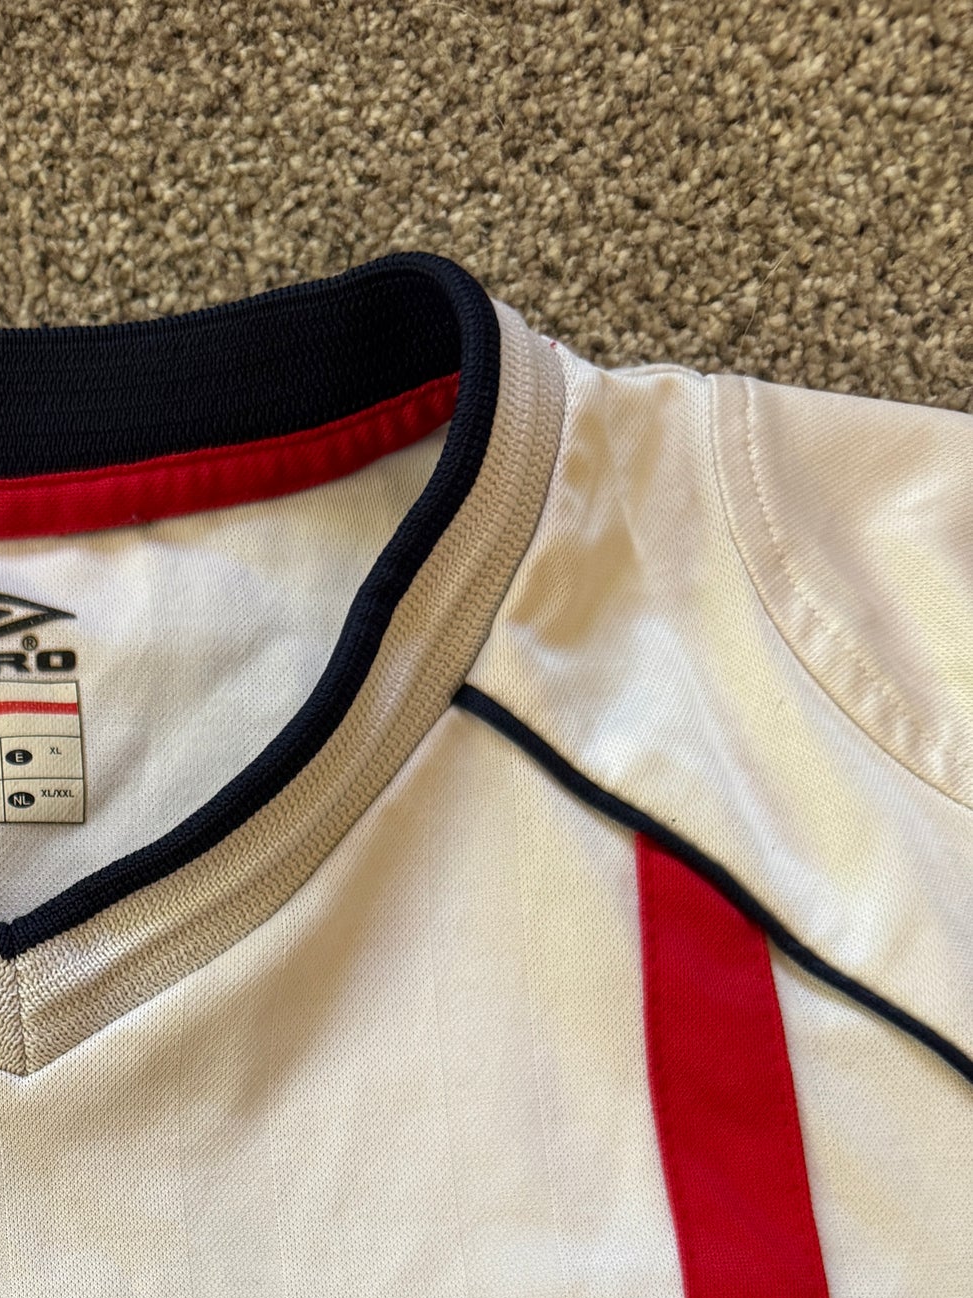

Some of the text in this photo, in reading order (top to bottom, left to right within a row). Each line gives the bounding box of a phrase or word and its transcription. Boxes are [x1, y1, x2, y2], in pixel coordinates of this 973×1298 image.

[49, 746, 62, 755] XL
[15, 752, 24, 763] E
[40, 789, 75, 798] XL/XXL
[13, 795, 31, 806] NL
